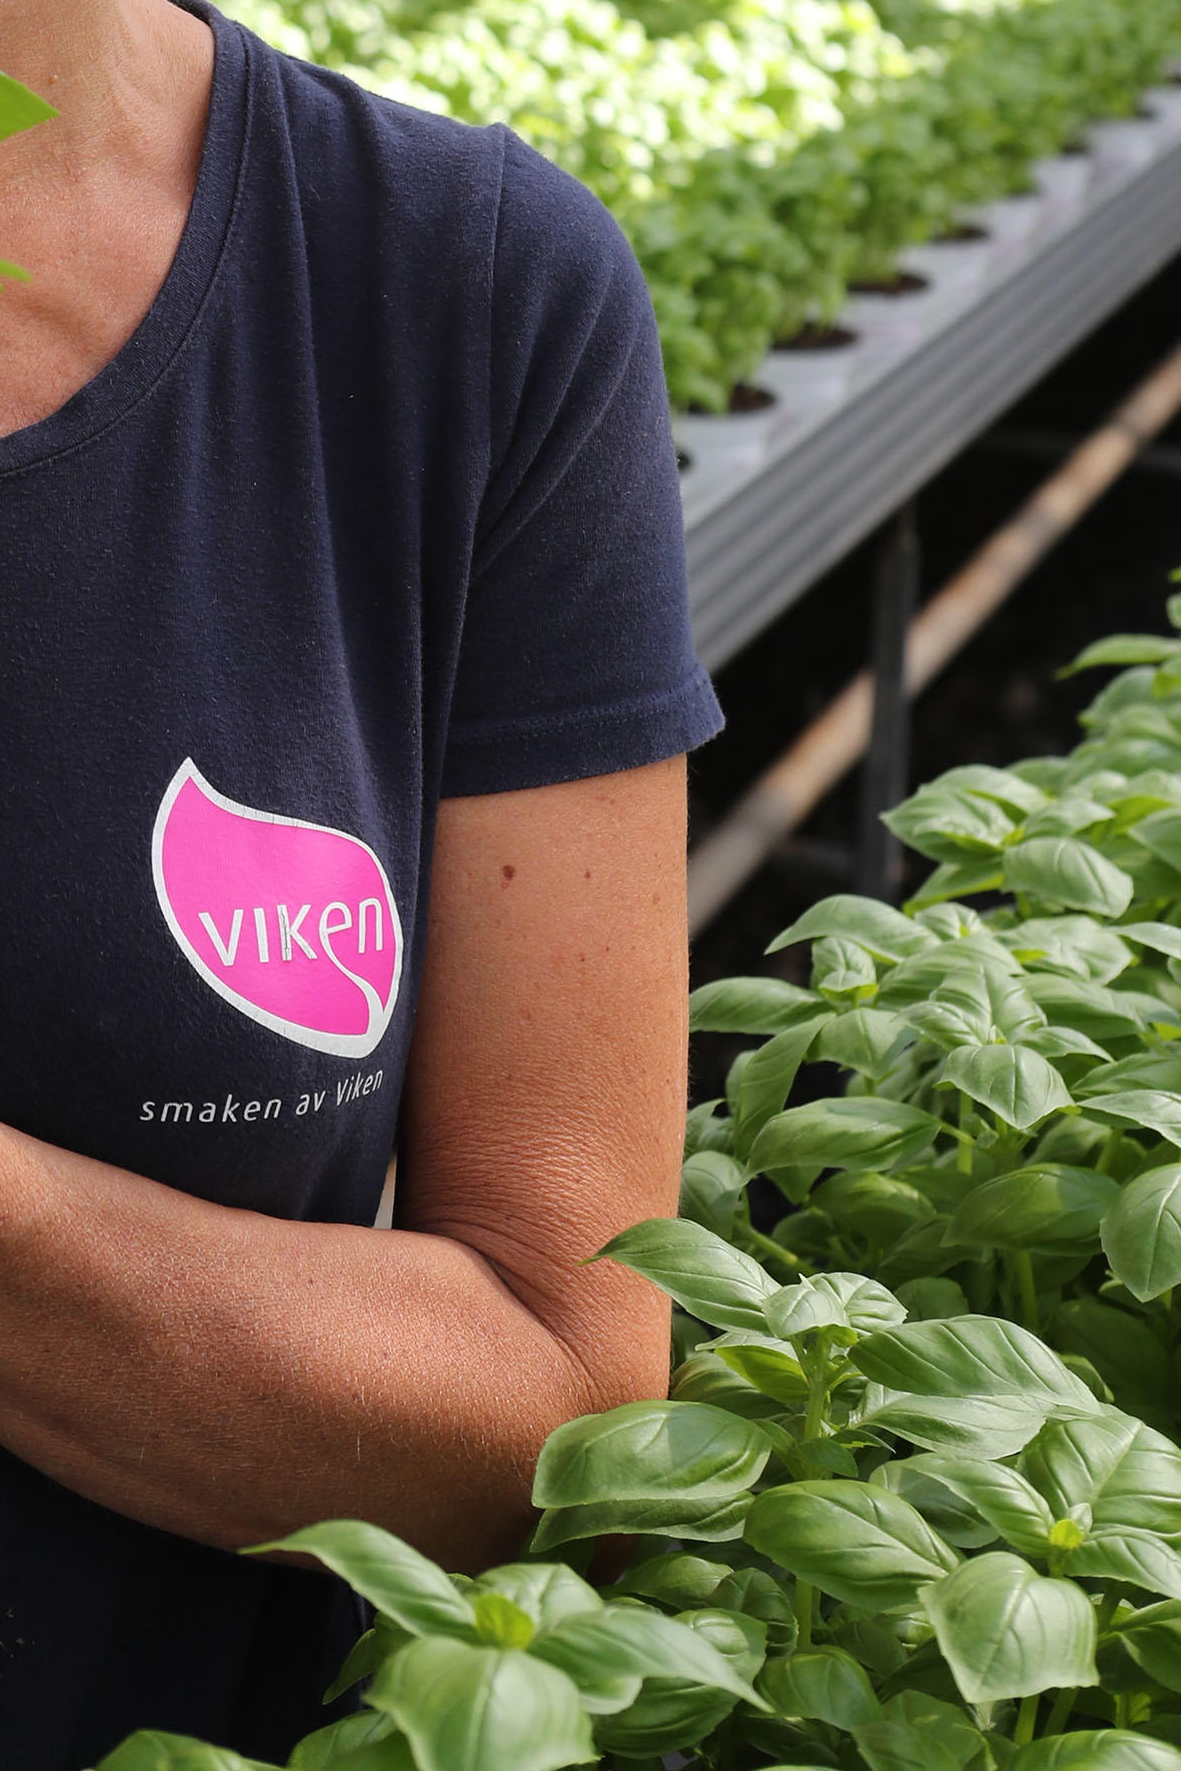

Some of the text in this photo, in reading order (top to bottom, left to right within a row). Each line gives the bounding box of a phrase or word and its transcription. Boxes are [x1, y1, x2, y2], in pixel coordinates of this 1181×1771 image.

[139, 1069, 383, 1123] smaken av Viken
